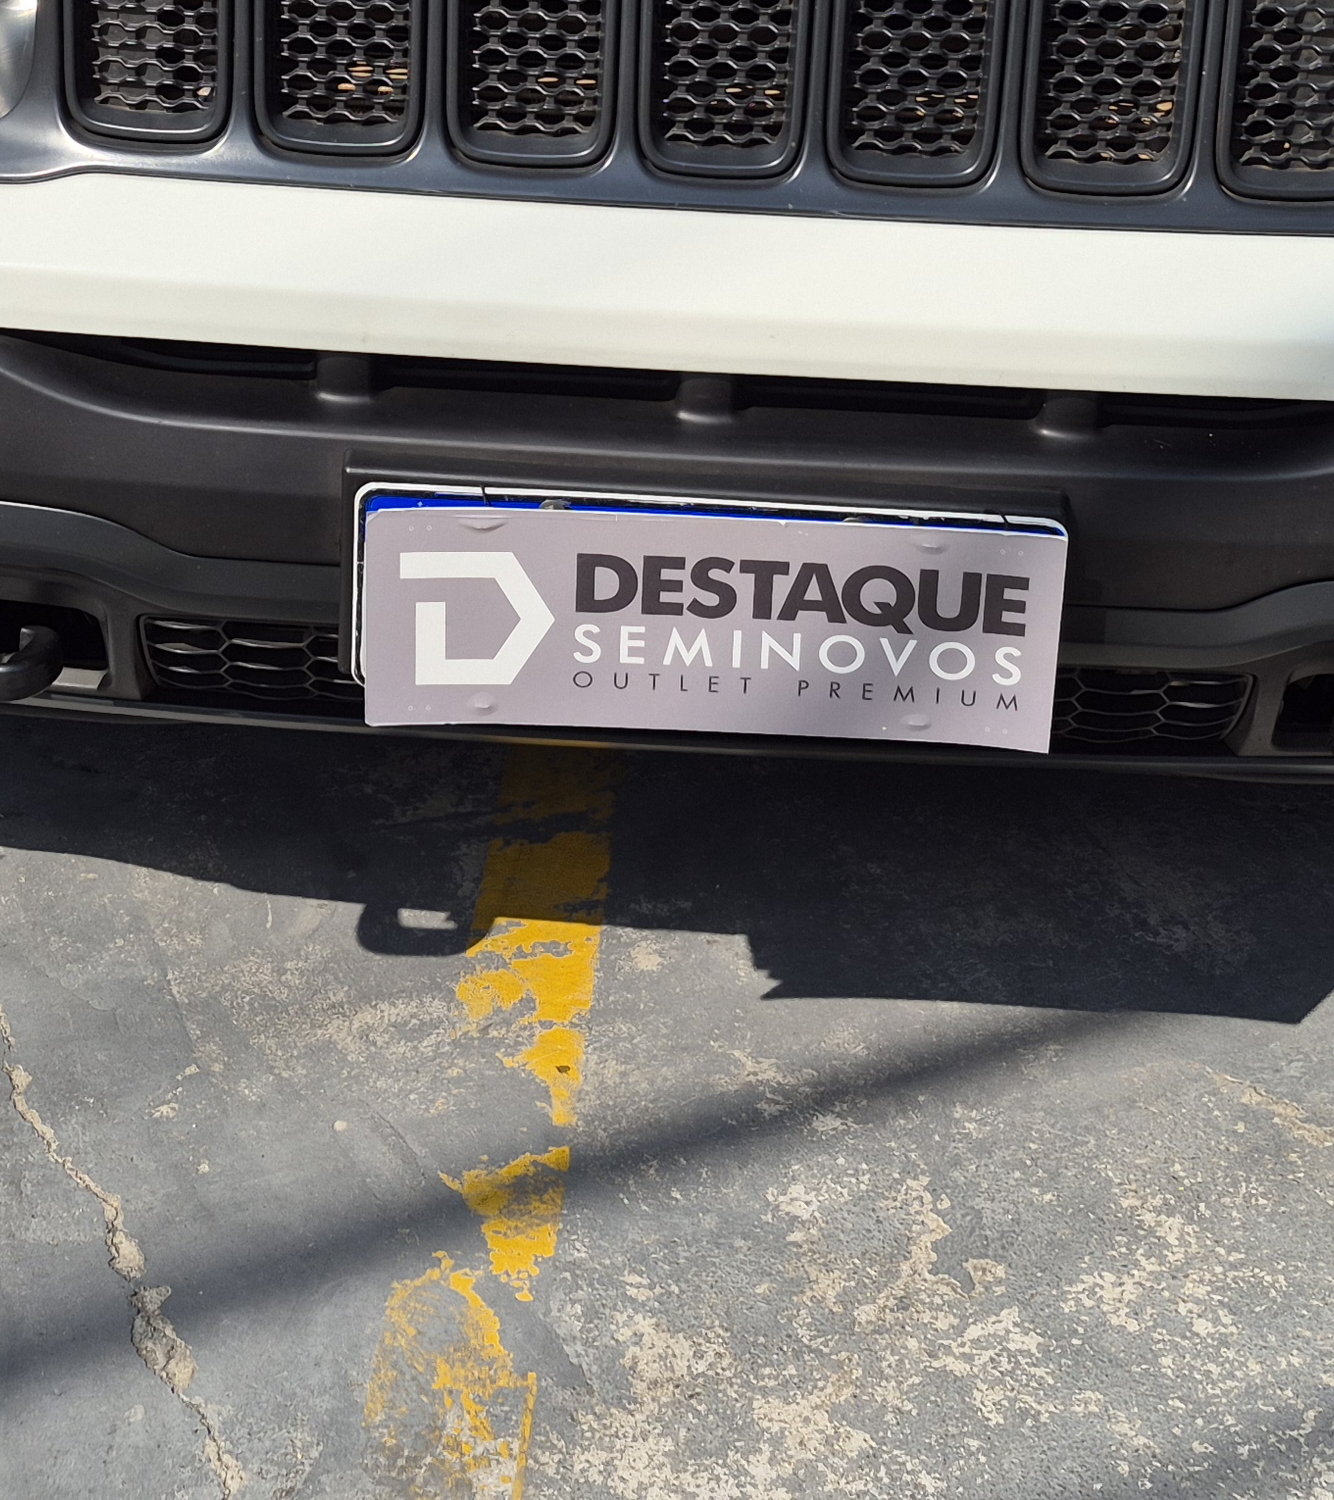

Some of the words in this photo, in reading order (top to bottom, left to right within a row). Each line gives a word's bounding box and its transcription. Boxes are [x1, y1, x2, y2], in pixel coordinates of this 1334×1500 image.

[575, 553, 1031, 637] DESTAQUE
[573, 624, 1024, 686] SEMINOVOS
[573, 671, 751, 696] OUTLET
[798, 679, 1020, 712] PREMIUM
